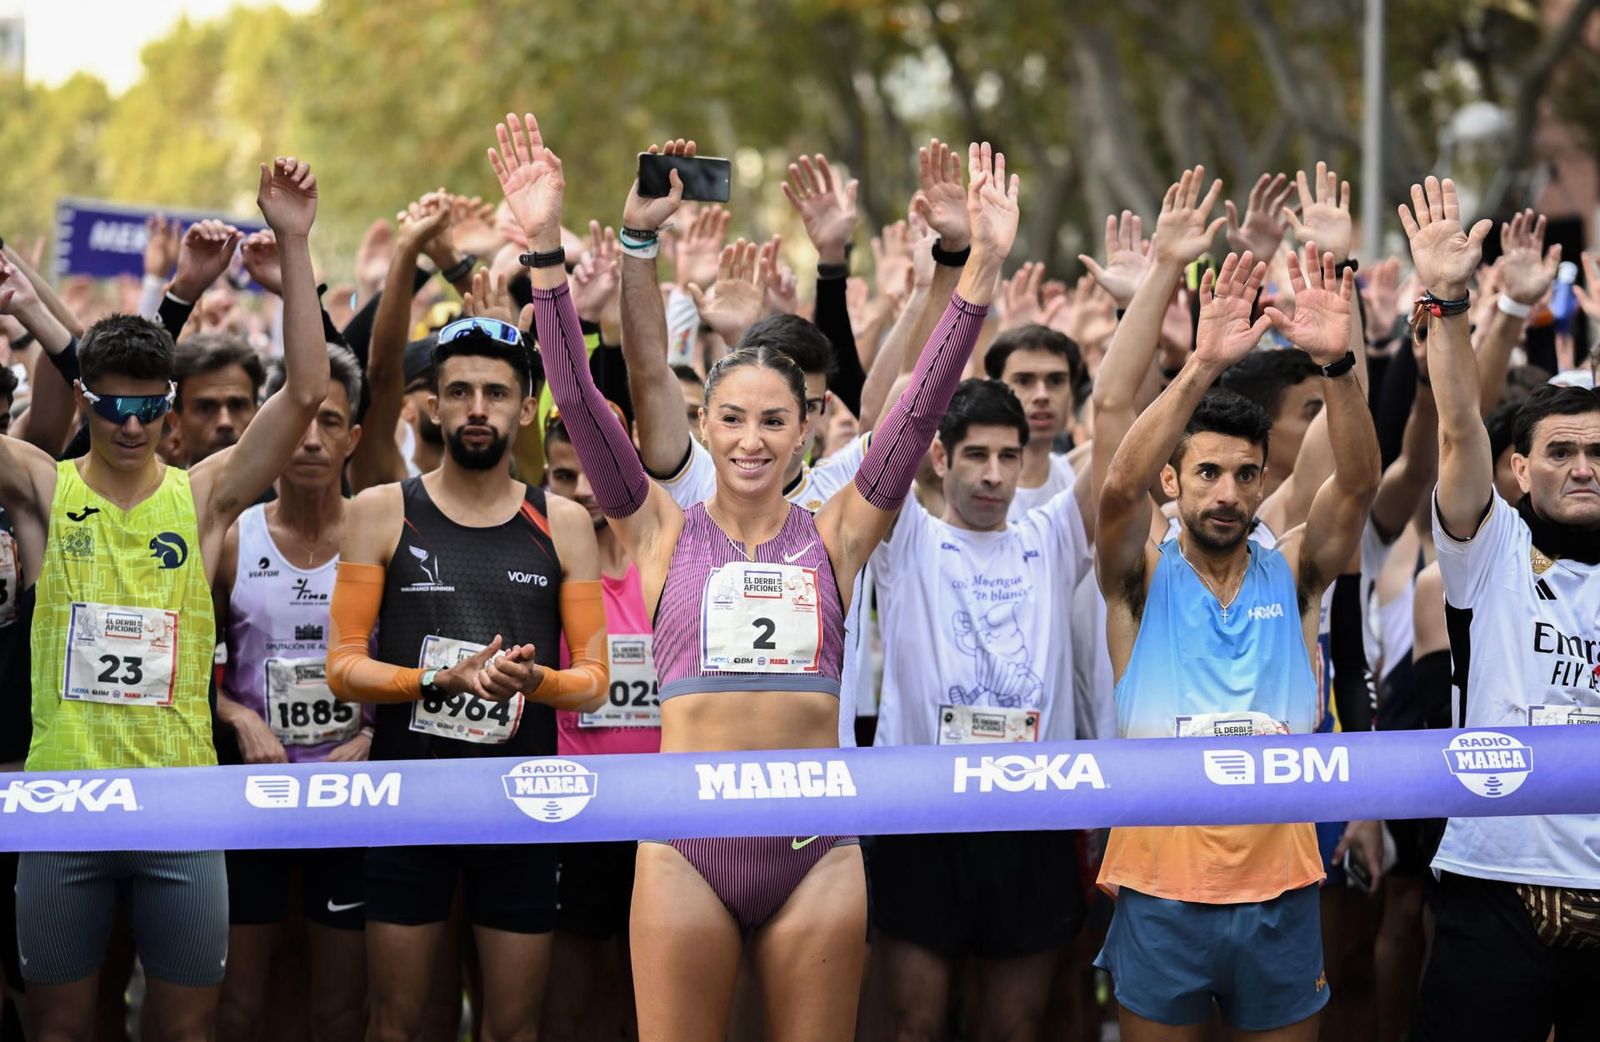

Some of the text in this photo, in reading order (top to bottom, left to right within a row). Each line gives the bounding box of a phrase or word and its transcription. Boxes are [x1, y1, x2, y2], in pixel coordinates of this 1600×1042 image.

[248, 570, 280, 579] VIATOR
[744, 576, 752, 584] EL
[754, 577, 776, 585] DERBI
[744, 584, 783, 593] AFICIONES
[1248, 603, 1284, 621] HOKA
[104, 625, 142, 634] AFICIONES
[751, 617, 776, 650] 2
[307, 642, 316, 651] DE
[97, 654, 143, 686] 23
[1551, 660, 1584, 688] FLY
[277, 698, 353, 729] 1885
[1213, 726, 1222, 734] EL
[1224, 726, 1247, 734] DERBI
[1459, 737, 1511, 748] RADIO
[521, 764, 576, 775] RADIO
[1263, 746, 1349, 784] BM
[1455, 749, 1526, 770] MARCA
[694, 760, 856, 800] MARCA
[953, 753, 1105, 793] HOKA
[307, 772, 401, 807] BM
[515, 775, 589, 795] MARCA
